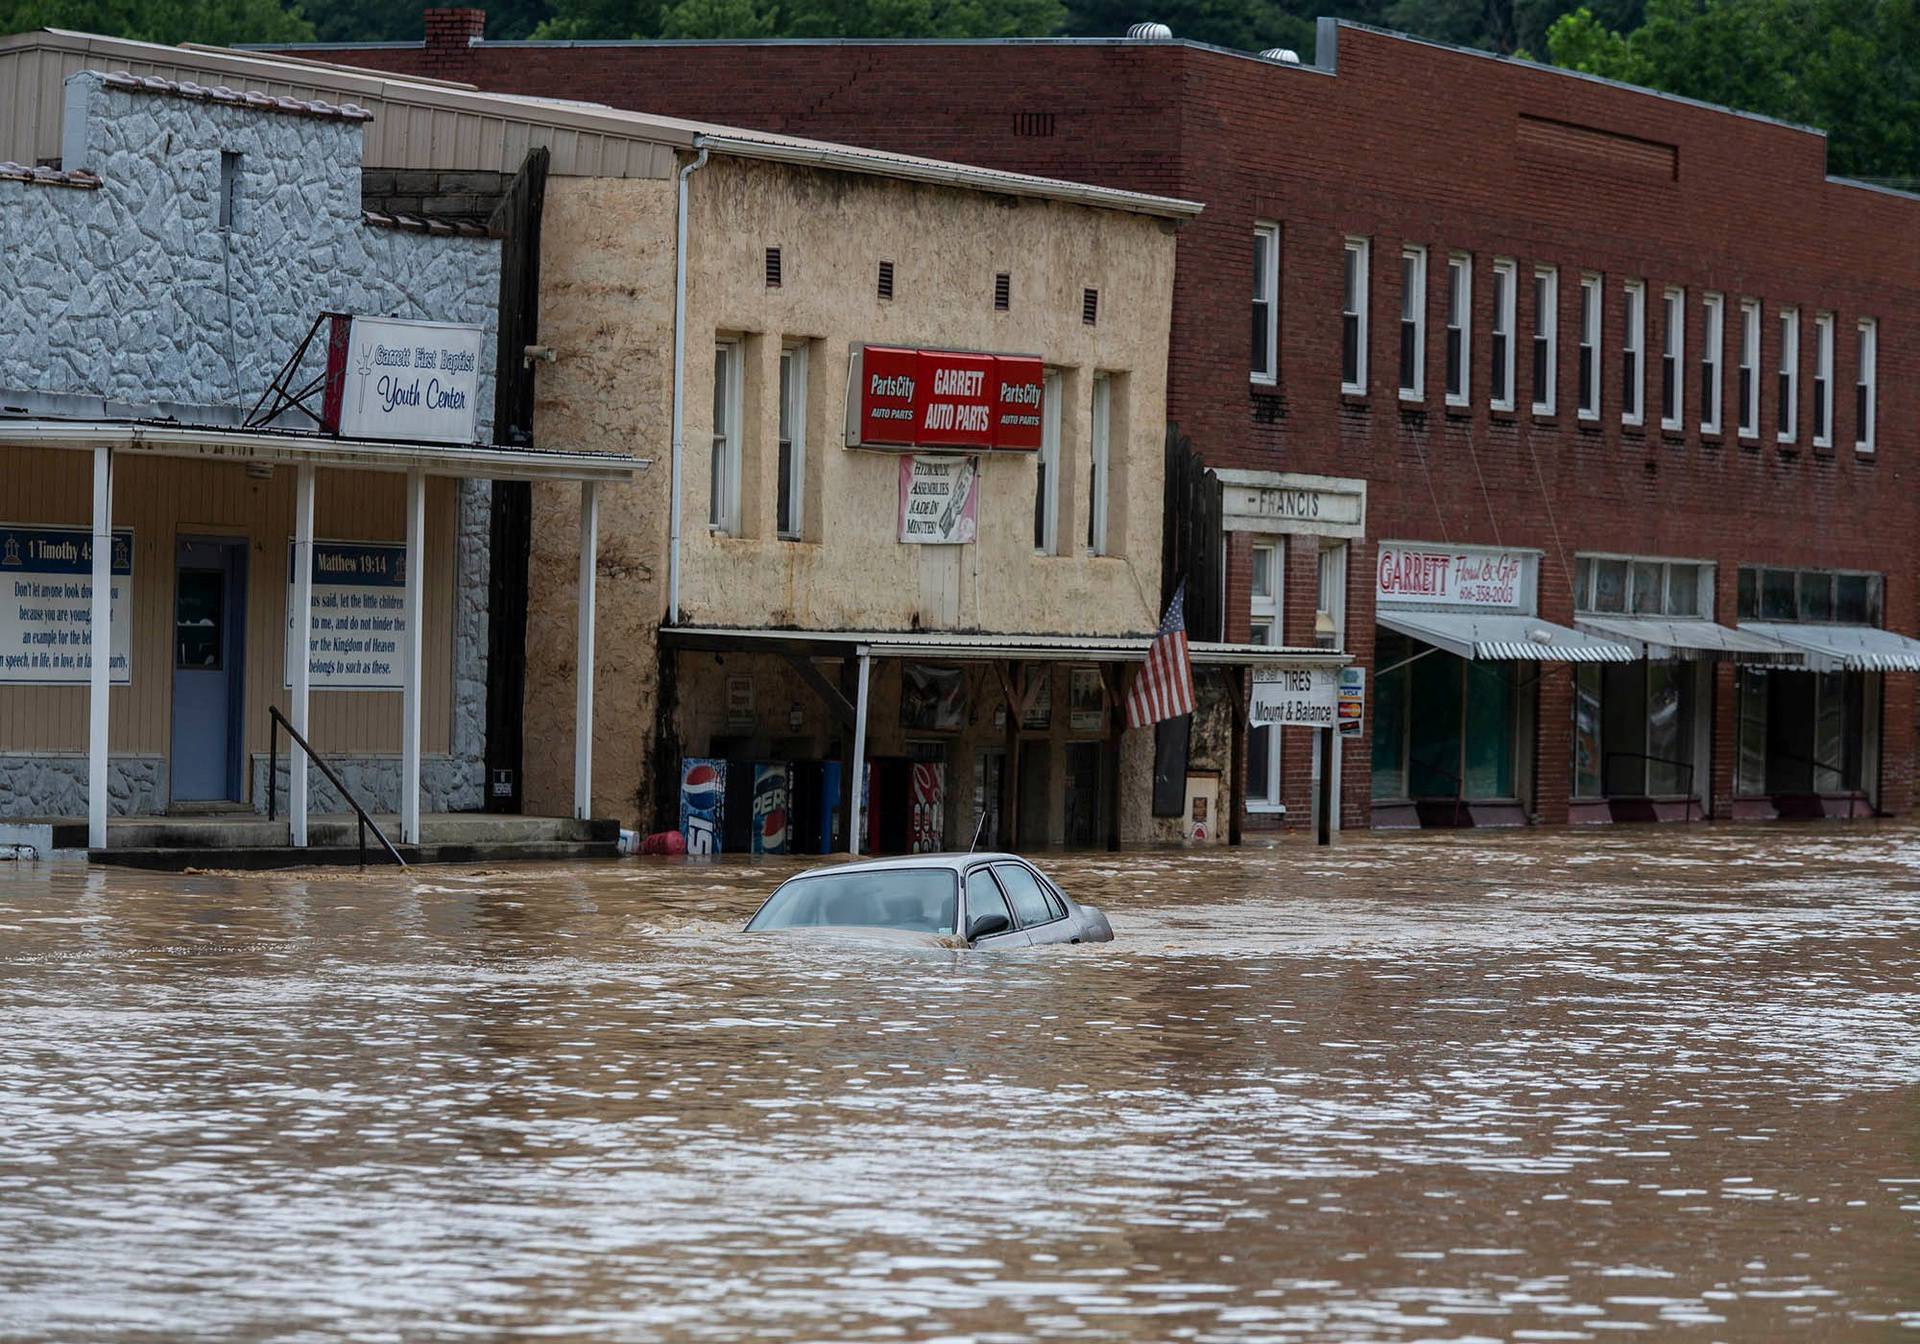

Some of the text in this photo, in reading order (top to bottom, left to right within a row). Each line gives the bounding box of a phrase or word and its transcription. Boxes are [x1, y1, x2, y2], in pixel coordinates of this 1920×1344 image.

[374, 344, 475, 375] Garrett First Baptist
[934, 368, 985, 397] GARRETT
[377, 375, 466, 413] Youth Center
[871, 407, 914, 420] AUTO PARTS
[924, 402, 989, 432] AUTO PARTS
[1000, 414, 1040, 426] AUTO PARTS
[909, 499, 939, 515] MADE IN
[28, 540, 34, 558] 1
[38, 540, 79, 563] Timothy
[318, 552, 386, 575] Matthew 19:14
[1379, 548, 1451, 596] GARRETT
[14, 581, 31, 598] Don't
[33, 582, 41, 598] let
[41, 584, 63, 602] anyone
[64, 583, 80, 599] look
[110, 588, 119, 599] ou
[321, 592, 339, 609] said,
[340, 592, 349, 608] let
[350, 593, 362, 609] the
[363, 593, 378, 609] little
[379, 594, 404, 610] children
[19, 605, 44, 621] because
[44, 608, 56, 625] you
[56, 609, 68, 621] are
[312, 617, 320, 631] to
[321, 617, 334, 632] me,
[335, 616, 349, 631] and
[350, 617, 359, 631] do
[360, 618, 371, 631] not
[372, 617, 393, 632] hinder
[22, 632, 32, 643] an
[32, 630, 58, 650] example
[58, 630, 69, 645] for
[70, 631, 81, 645] the
[320, 637, 332, 651] the
[333, 637, 363, 656] Kingdom
[364, 638, 372, 652] of
[372, 638, 396, 653] Heaven
[5, 652, 30, 671] speech,
[31, 652, 39, 668] in
[39, 653, 52, 669] life,
[52, 653, 60, 668] in
[60, 653, 75, 669] love,
[76, 653, 84, 669] in
[309, 659, 392, 677] belongs to such as these.
[1284, 670, 1312, 691] TIRES
[1255, 700, 1332, 721] Mount & Balance
